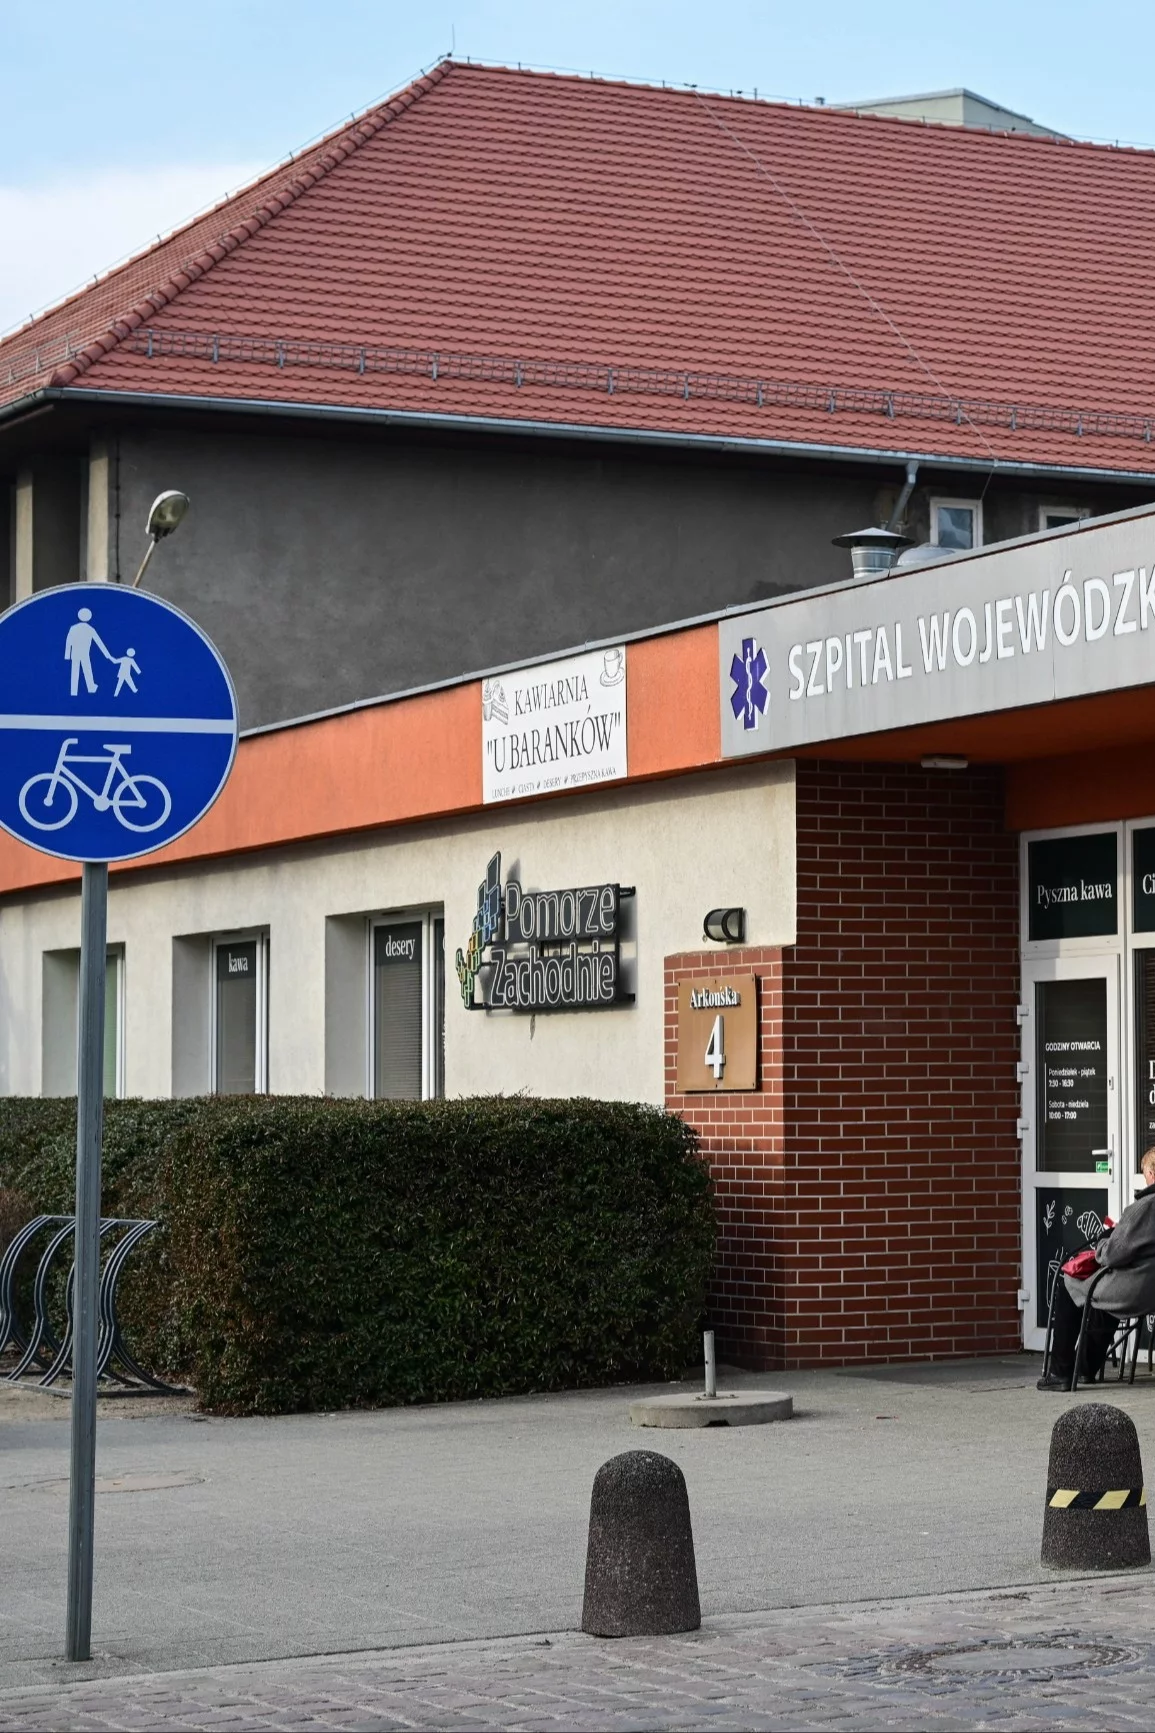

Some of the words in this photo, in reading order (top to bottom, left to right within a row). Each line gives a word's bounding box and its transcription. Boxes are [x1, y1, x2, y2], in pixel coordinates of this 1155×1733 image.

[787, 622, 913, 701] SZPITAL
[514, 674, 589, 716] KAWIARNIA
[510, 704, 622, 770] BARANKÓW"
[1037, 884, 1078, 910] Pyszna
[1080, 879, 1112, 901] kawa
[504, 881, 616, 940] Pomorze
[228, 952, 248, 972] kawa
[386, 935, 416, 960] desery
[490, 940, 615, 1006] Zachodnie
[690, 986, 740, 1009] Arkońska
[704, 1014, 726, 1080] 4
[1046, 1042, 1070, 1051] GODZINY
[1070, 1041, 1100, 1050] OTWARCIA
[1048, 1068, 1077, 1076] Poniedziałek
[1081, 1067, 1096, 1078] piątek
[1048, 1100, 1065, 1108] Sobota
[1068, 1100, 1089, 1108] niedziela
